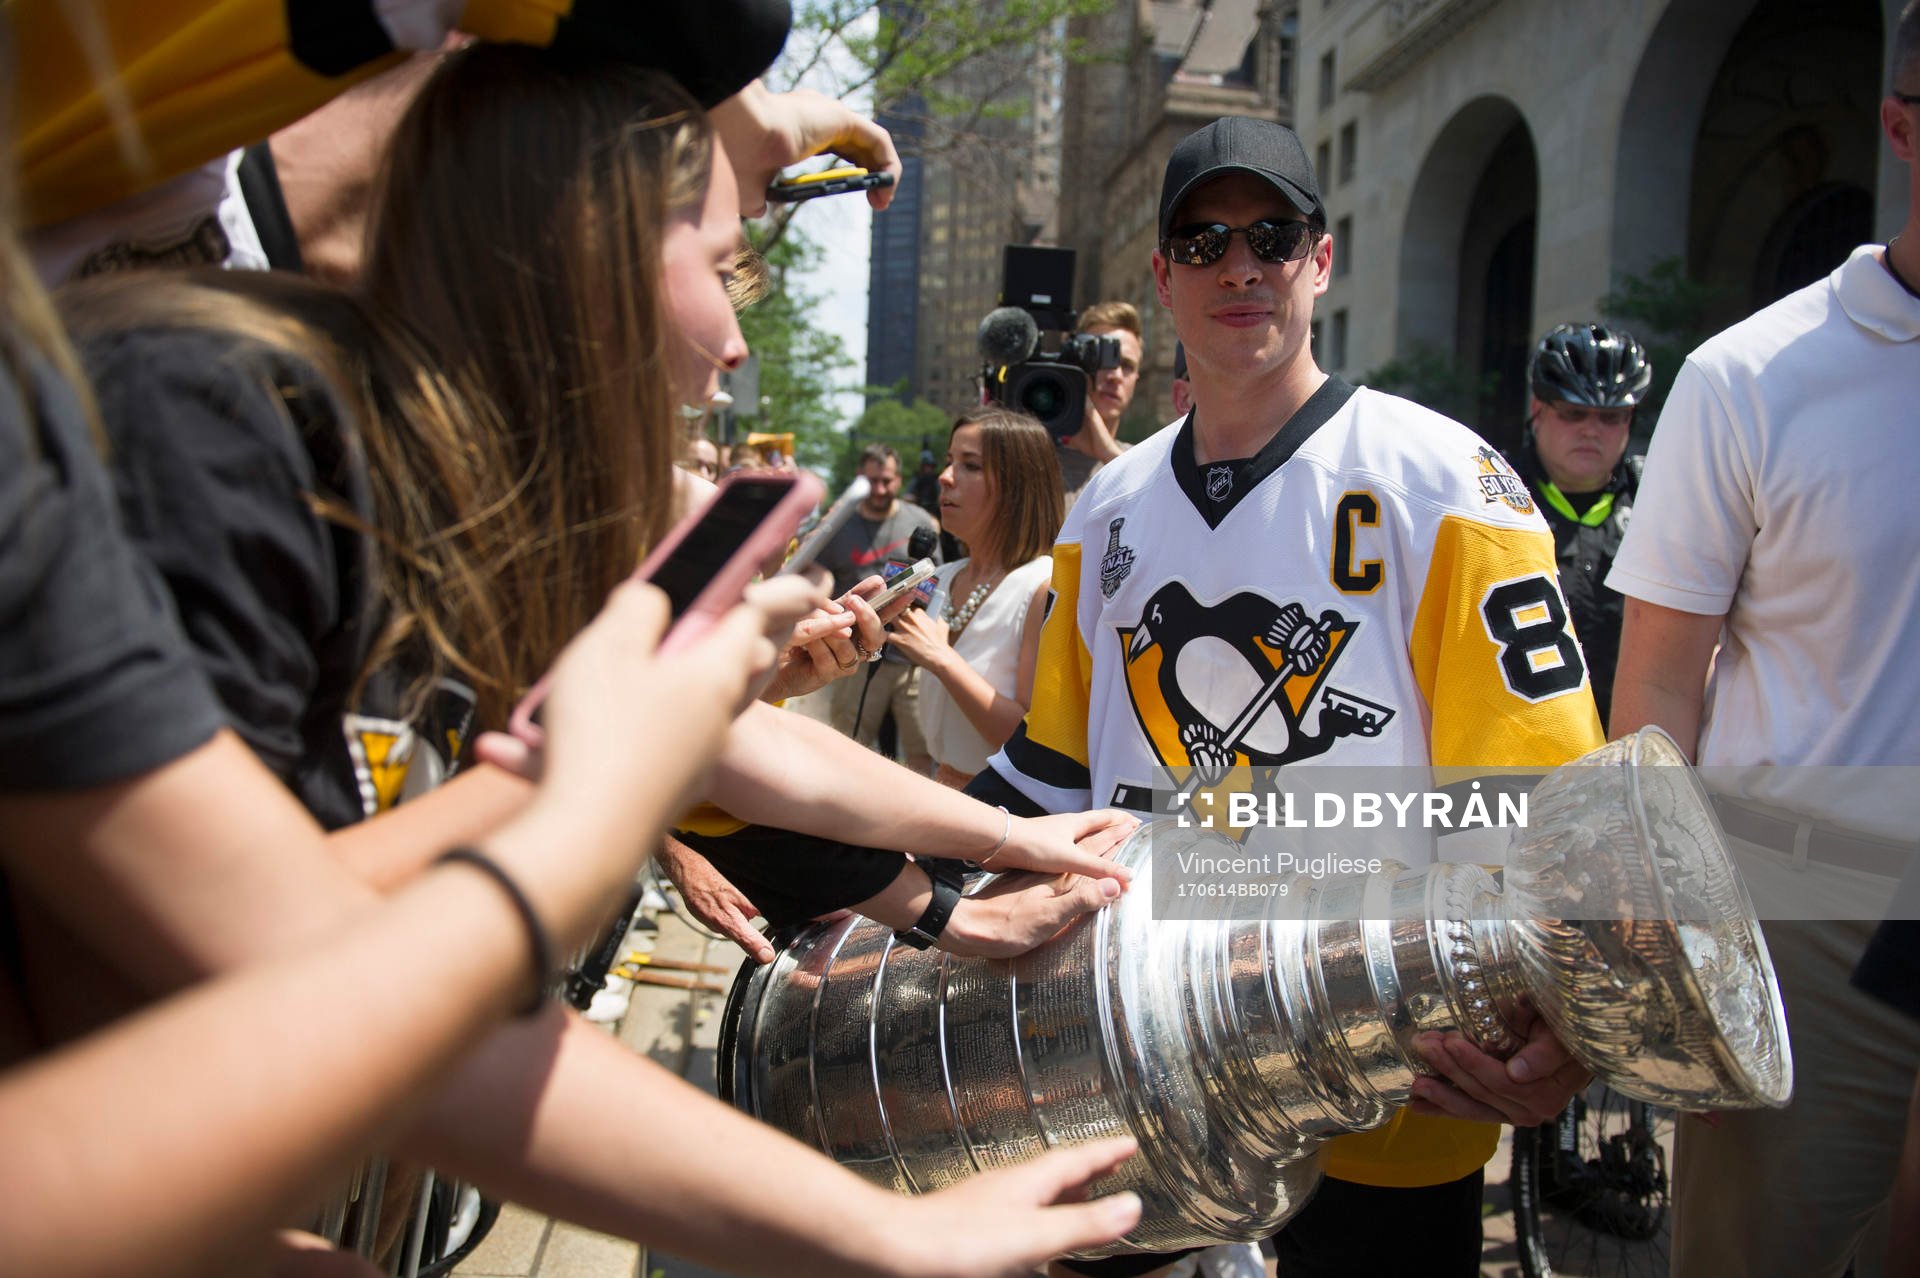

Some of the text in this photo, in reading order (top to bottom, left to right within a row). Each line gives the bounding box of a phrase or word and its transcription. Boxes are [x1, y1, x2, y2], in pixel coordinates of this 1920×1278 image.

[1211, 476, 1228, 494] NHL
[1480, 476, 1503, 494] 50
[1329, 490, 1385, 595] C
